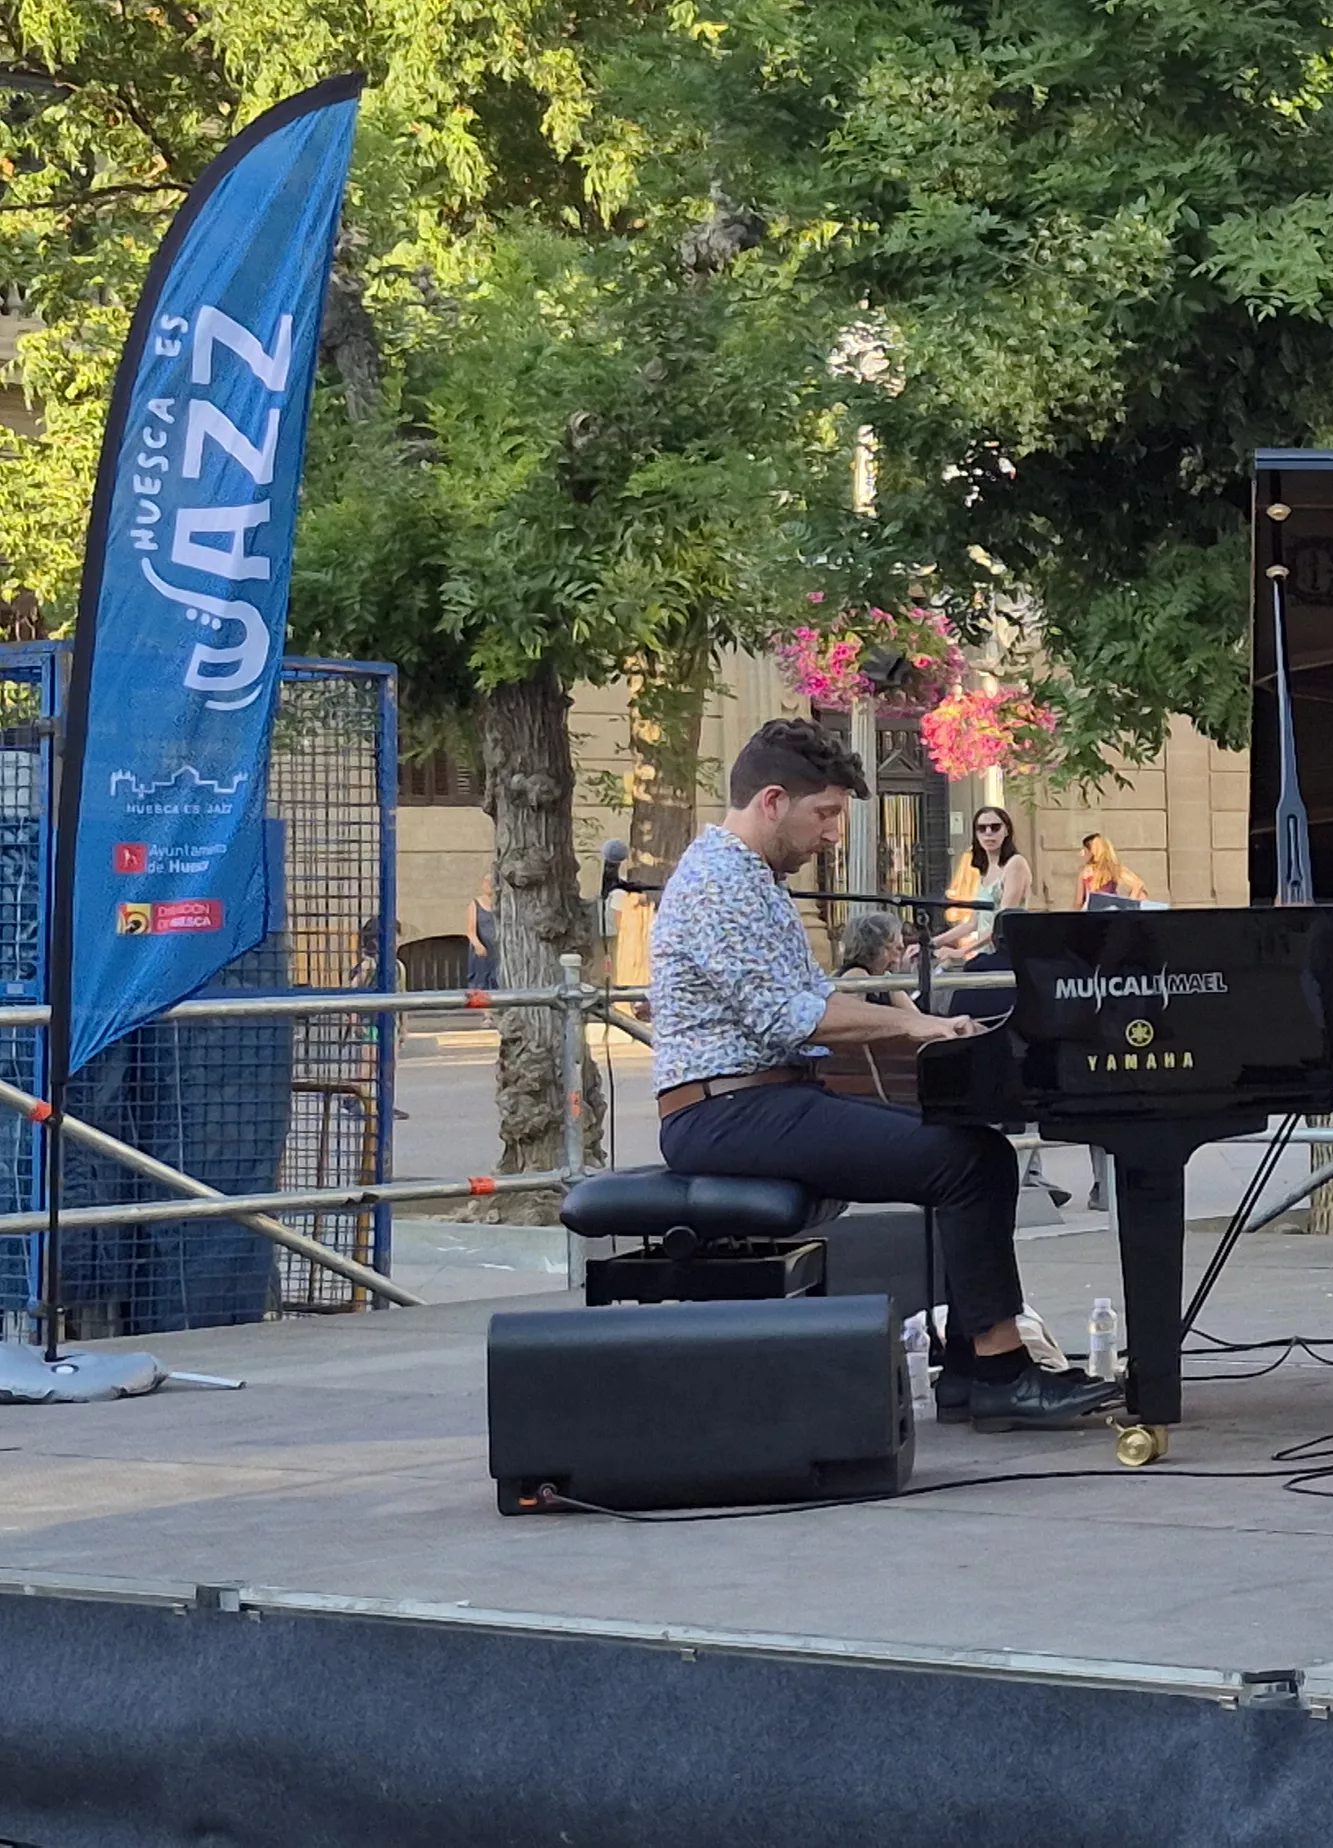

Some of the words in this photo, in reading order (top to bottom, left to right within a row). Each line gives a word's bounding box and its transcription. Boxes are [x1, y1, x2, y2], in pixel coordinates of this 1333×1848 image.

[129, 397, 176, 551] HUESCA
[155, 313, 189, 358] ES
[140, 303, 295, 712] JAZZ
[1086, 1051, 1195, 1072] YAMAHA
